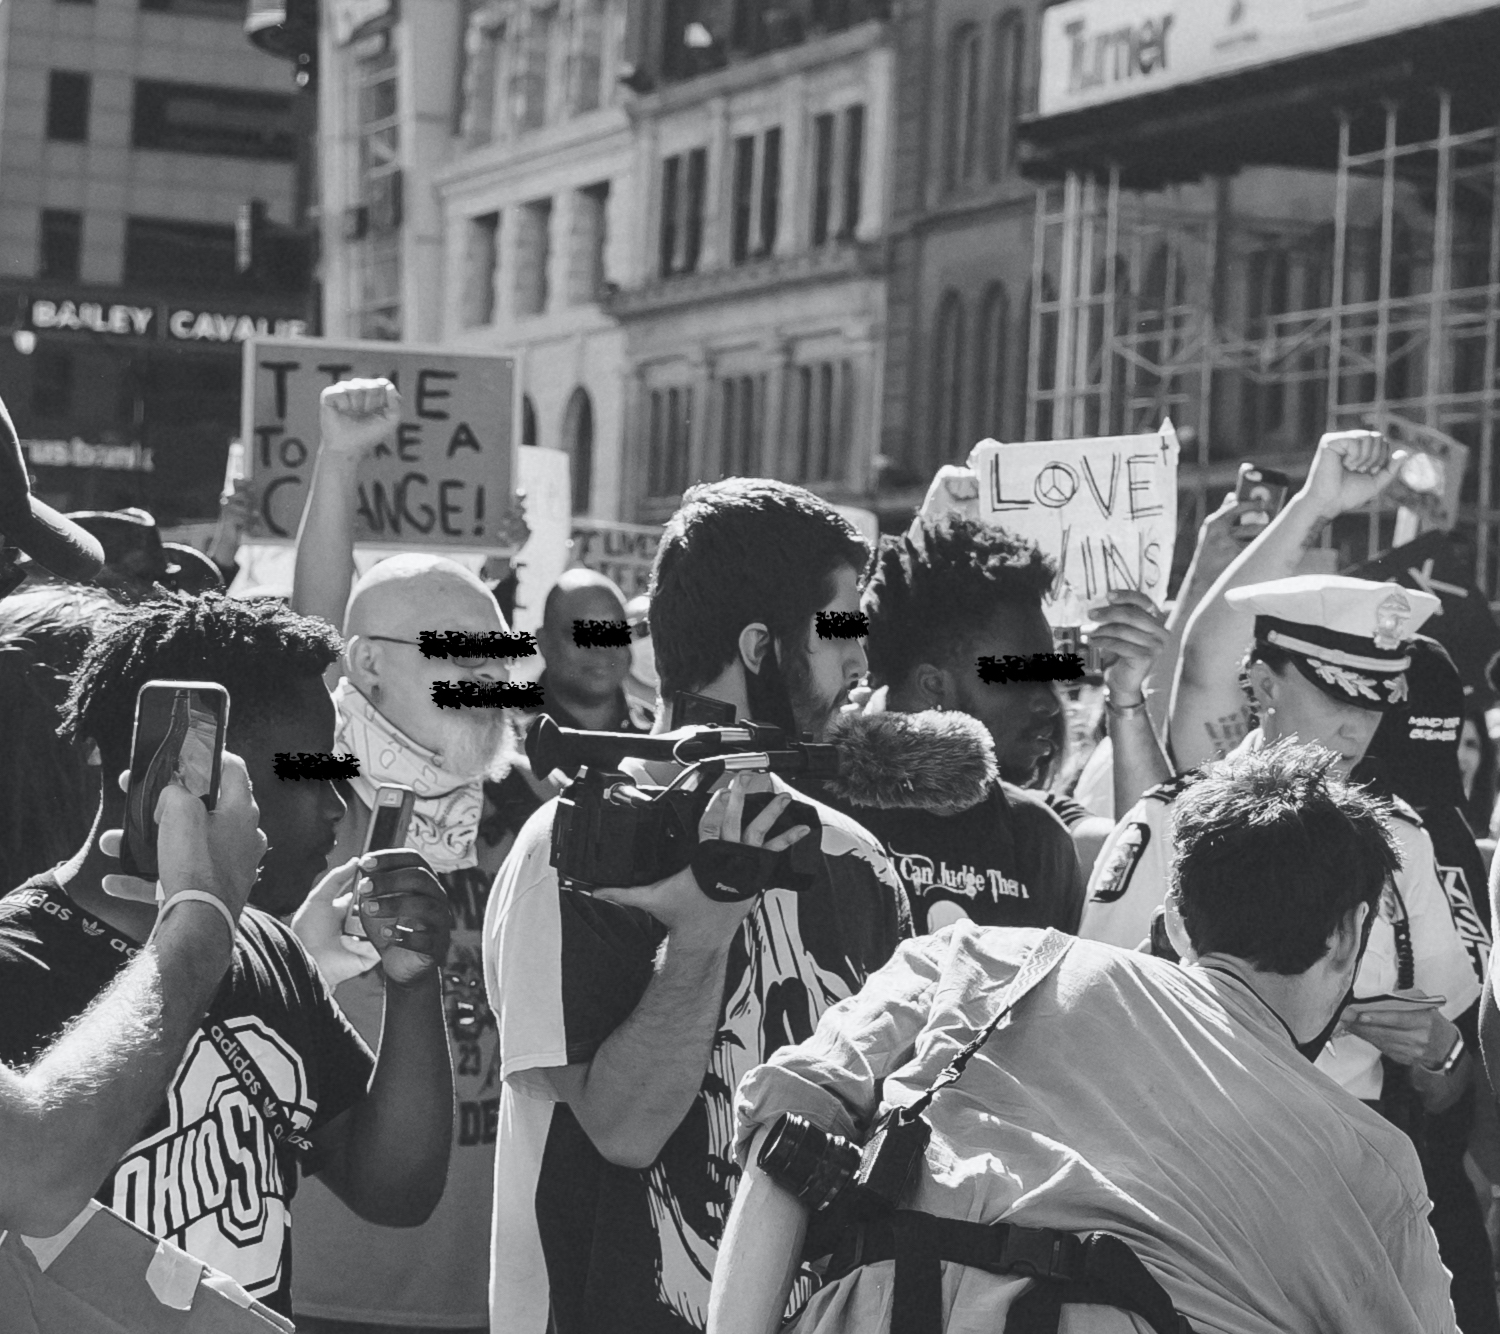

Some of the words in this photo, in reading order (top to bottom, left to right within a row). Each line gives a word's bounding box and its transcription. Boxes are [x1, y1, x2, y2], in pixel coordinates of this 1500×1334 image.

[1062, 13, 1177, 96] Turner
[32, 300, 153, 335] BAILEY
[989, 452, 1165, 521] LOVE
[938, 861, 986, 901] Judge
[210, 1024, 262, 1096] adidas
